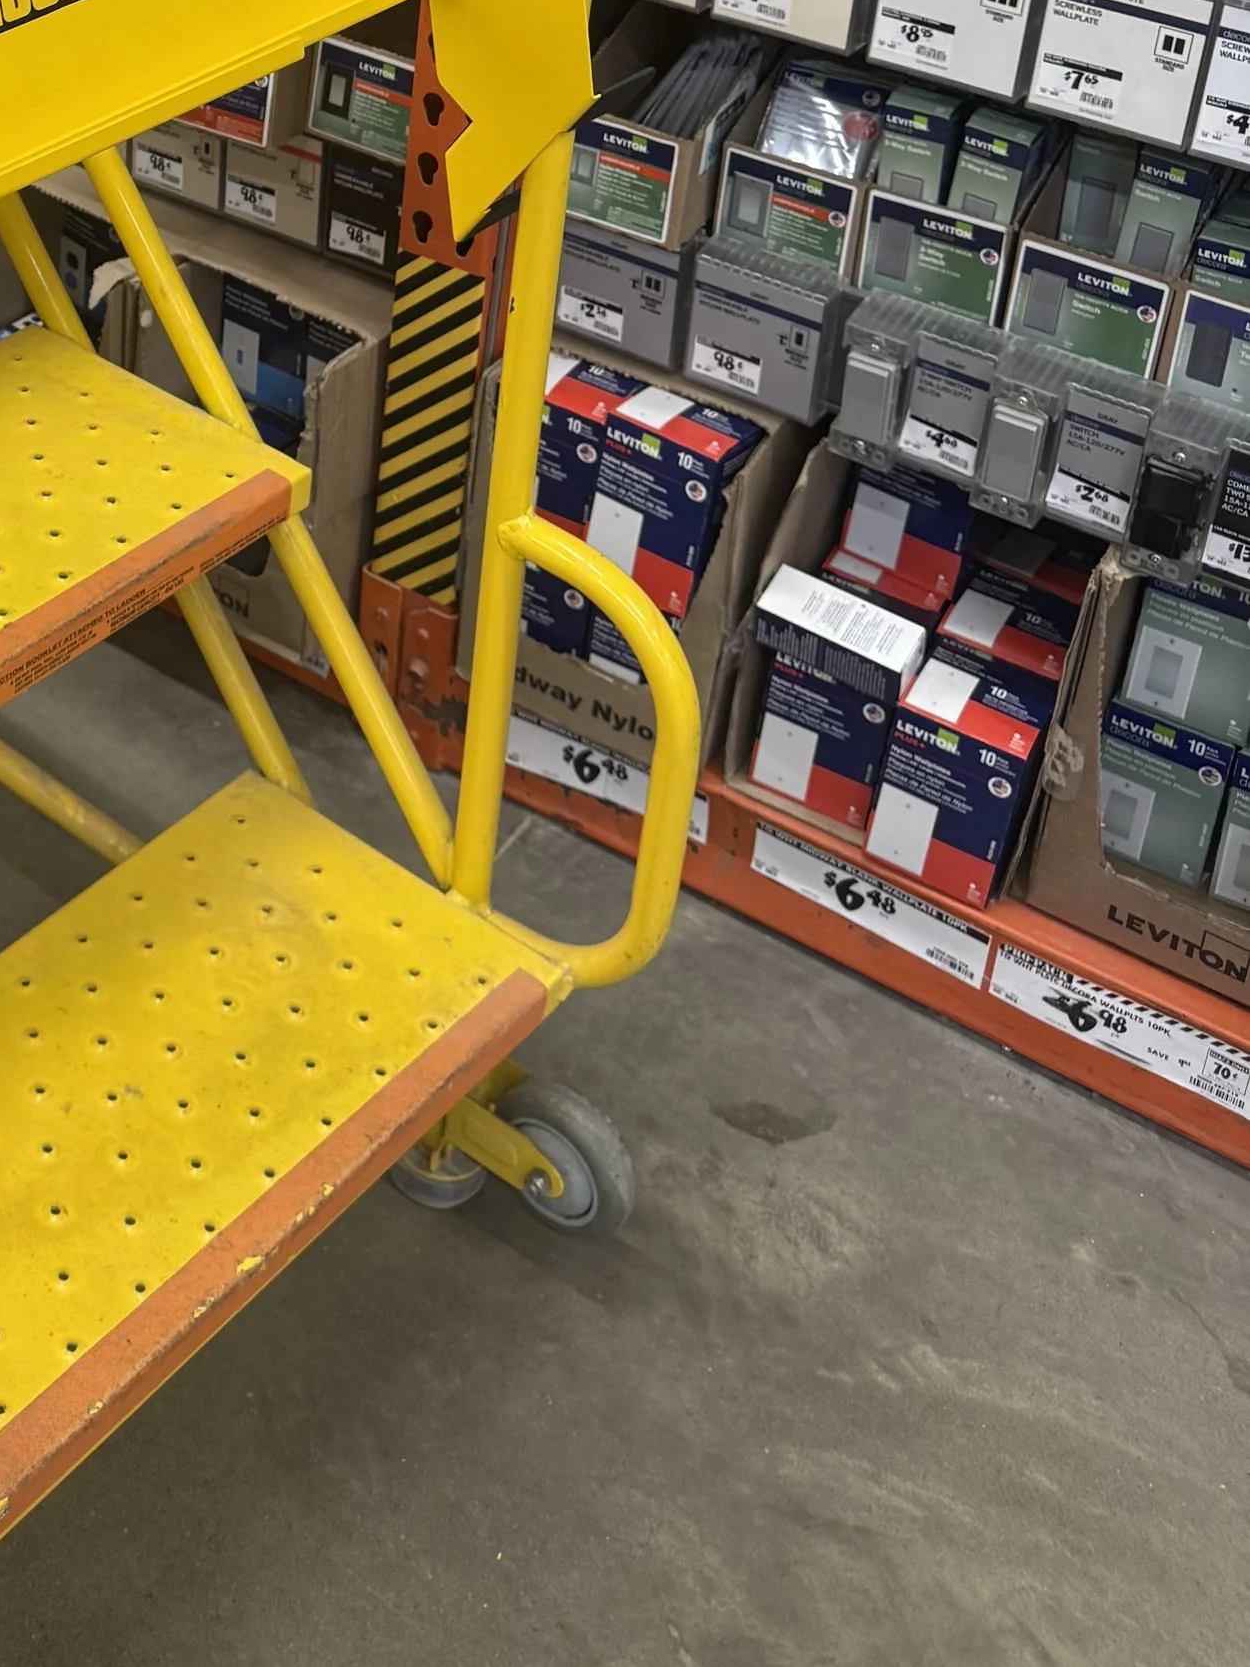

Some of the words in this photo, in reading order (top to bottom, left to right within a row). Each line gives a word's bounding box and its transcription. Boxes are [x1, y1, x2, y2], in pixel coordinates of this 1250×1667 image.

[1053, 8, 1099, 26] WALLPLATE
[1054, 0, 1102, 17] SCREWLESS
[359, 61, 396, 80] LEVITON
[886, 113, 928, 131] LEVITON
[604, 133, 647, 153] LEVITON
[965, 136, 1008, 156] LEVITON
[1140, 163, 1186, 185] LEVITON
[777, 175, 823, 196] LEVITON
[923, 218, 973, 240] LEVITON
[1198, 248, 1245, 268] LEVITON
[1078, 272, 1130, 296] LEVITON
[567, 417, 582, 434] 10
[606, 425, 660, 460] LEVITON
[1065, 438, 1091, 453] AC/CA
[677, 452, 693, 470] 10
[1222, 503, 1249, 518] AC/CA
[116, 589, 146, 611] LADDER
[515, 666, 581, 711] dway
[592, 699, 653, 740] Nylo
[896, 719, 958, 754] LEVITON
[1112, 715, 1174, 748] LEVITON
[1188, 739, 1205, 756] 10
[978, 749, 996, 767] 10
[1107, 904, 1248, 984] LEVITON
[1100, 999, 1144, 1024] WALLPLTS
[1148, 1021, 1171, 1036] 10PK
[1147, 1048, 1168, 1060] SAVE
